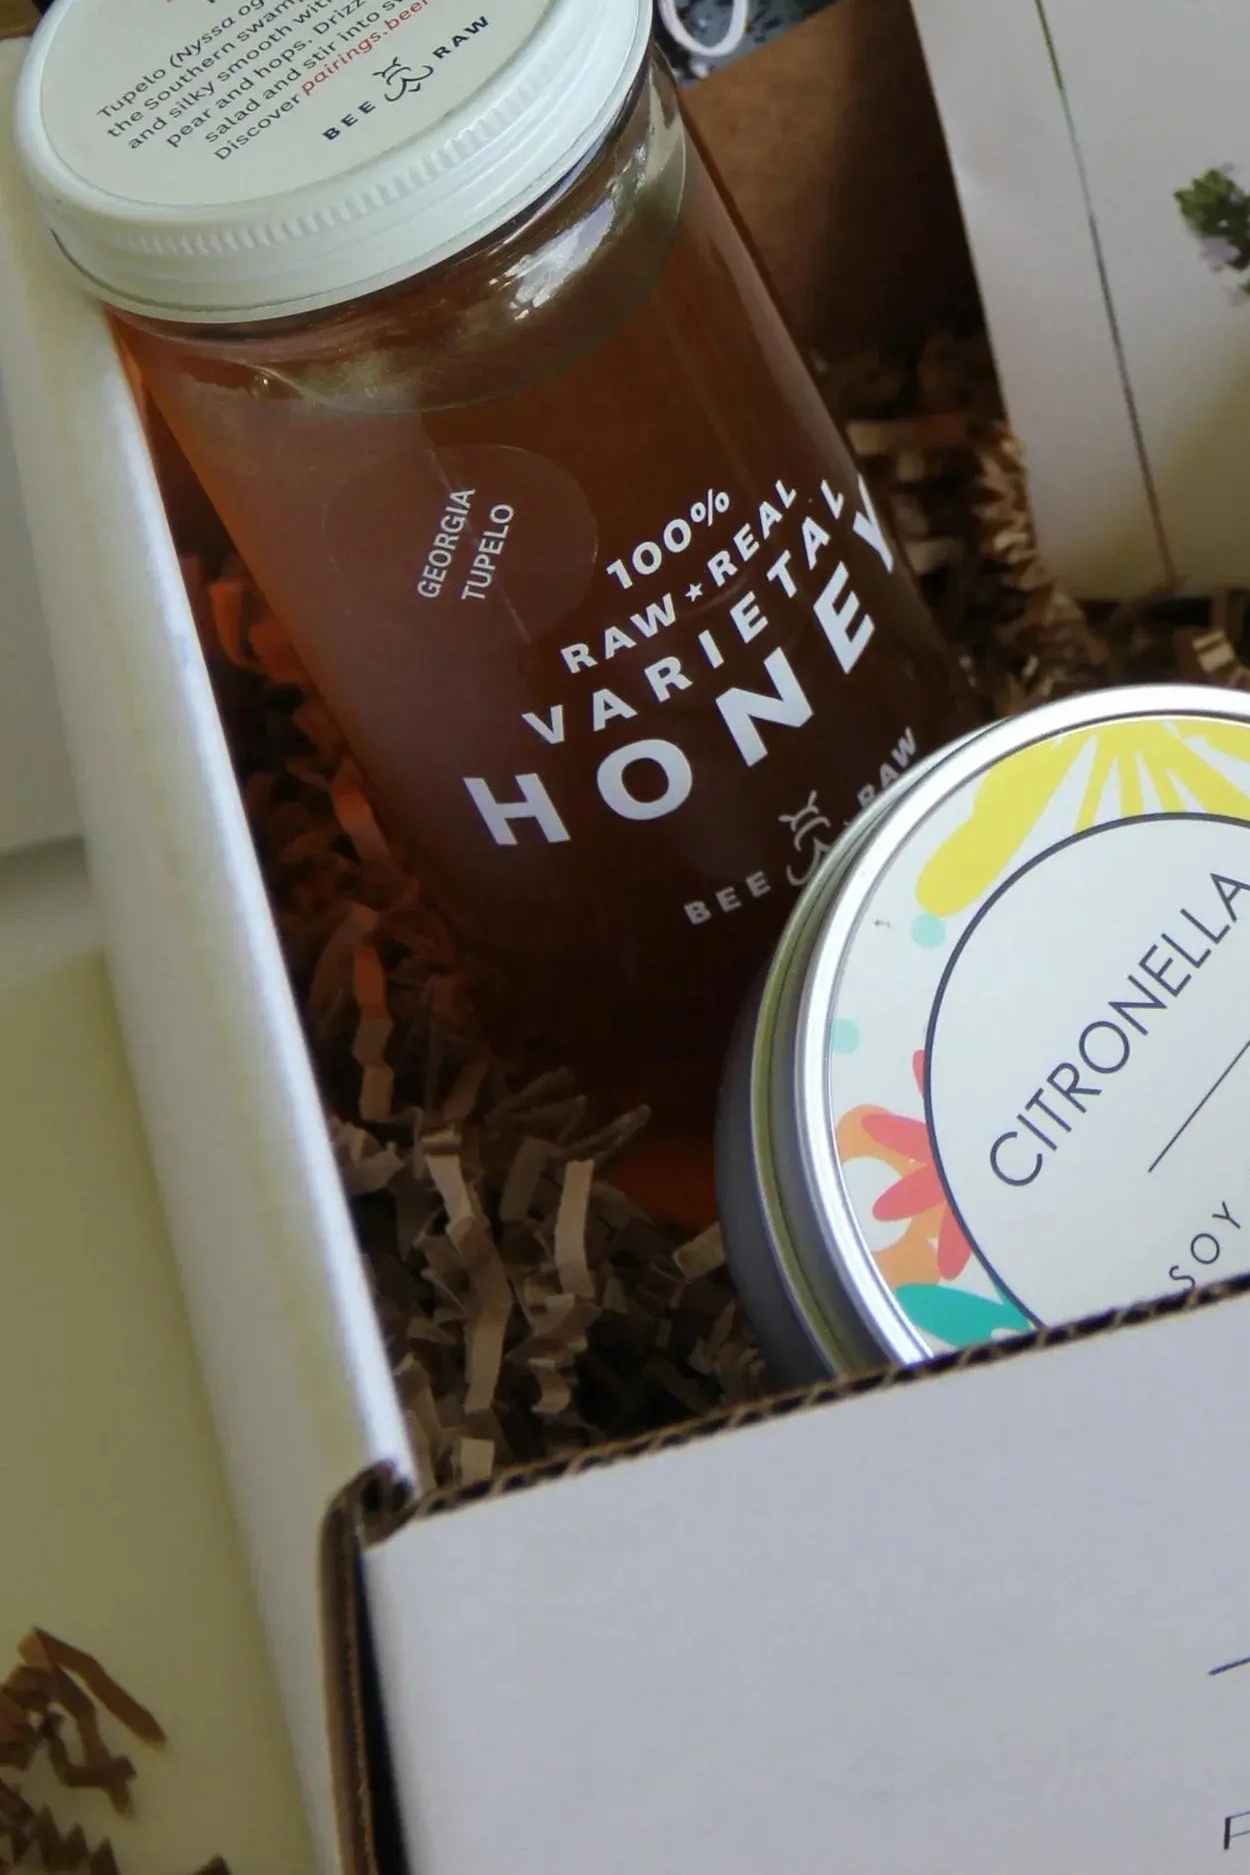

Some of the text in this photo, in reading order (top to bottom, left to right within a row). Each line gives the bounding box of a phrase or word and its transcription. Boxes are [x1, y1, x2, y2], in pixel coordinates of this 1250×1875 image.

[97, 68, 166, 118] Tupelo
[170, 16, 236, 68] (Nyssa
[107, 111, 143, 137] the
[143, 41, 236, 111] Southern
[128, 117, 167, 149] and
[169, 81, 216, 118] silky
[217, 26, 293, 82] smooth
[166, 108, 213, 148] pear
[215, 77, 255, 110] and
[253, 38, 313, 79] hops.
[205, 98, 261, 143] salad
[262, 67, 302, 100] and
[303, 41, 337, 70] stir
[337, 11, 380, 42] into
[322, 15, 490, 141] BEE RAW
[214, 93, 301, 161] Discover
[417, 487, 475, 599] GEORGIA
[461, 503, 514, 604] TUPELO
[560, 479, 797, 674] RAW REAL
[606, 488, 731, 590] 100%
[462, 473, 894, 846] HONEY
[521, 479, 844, 745] VARIETAL
[683, 870, 772, 925] BEE
[1168, 1200, 1243, 1291] SOY
